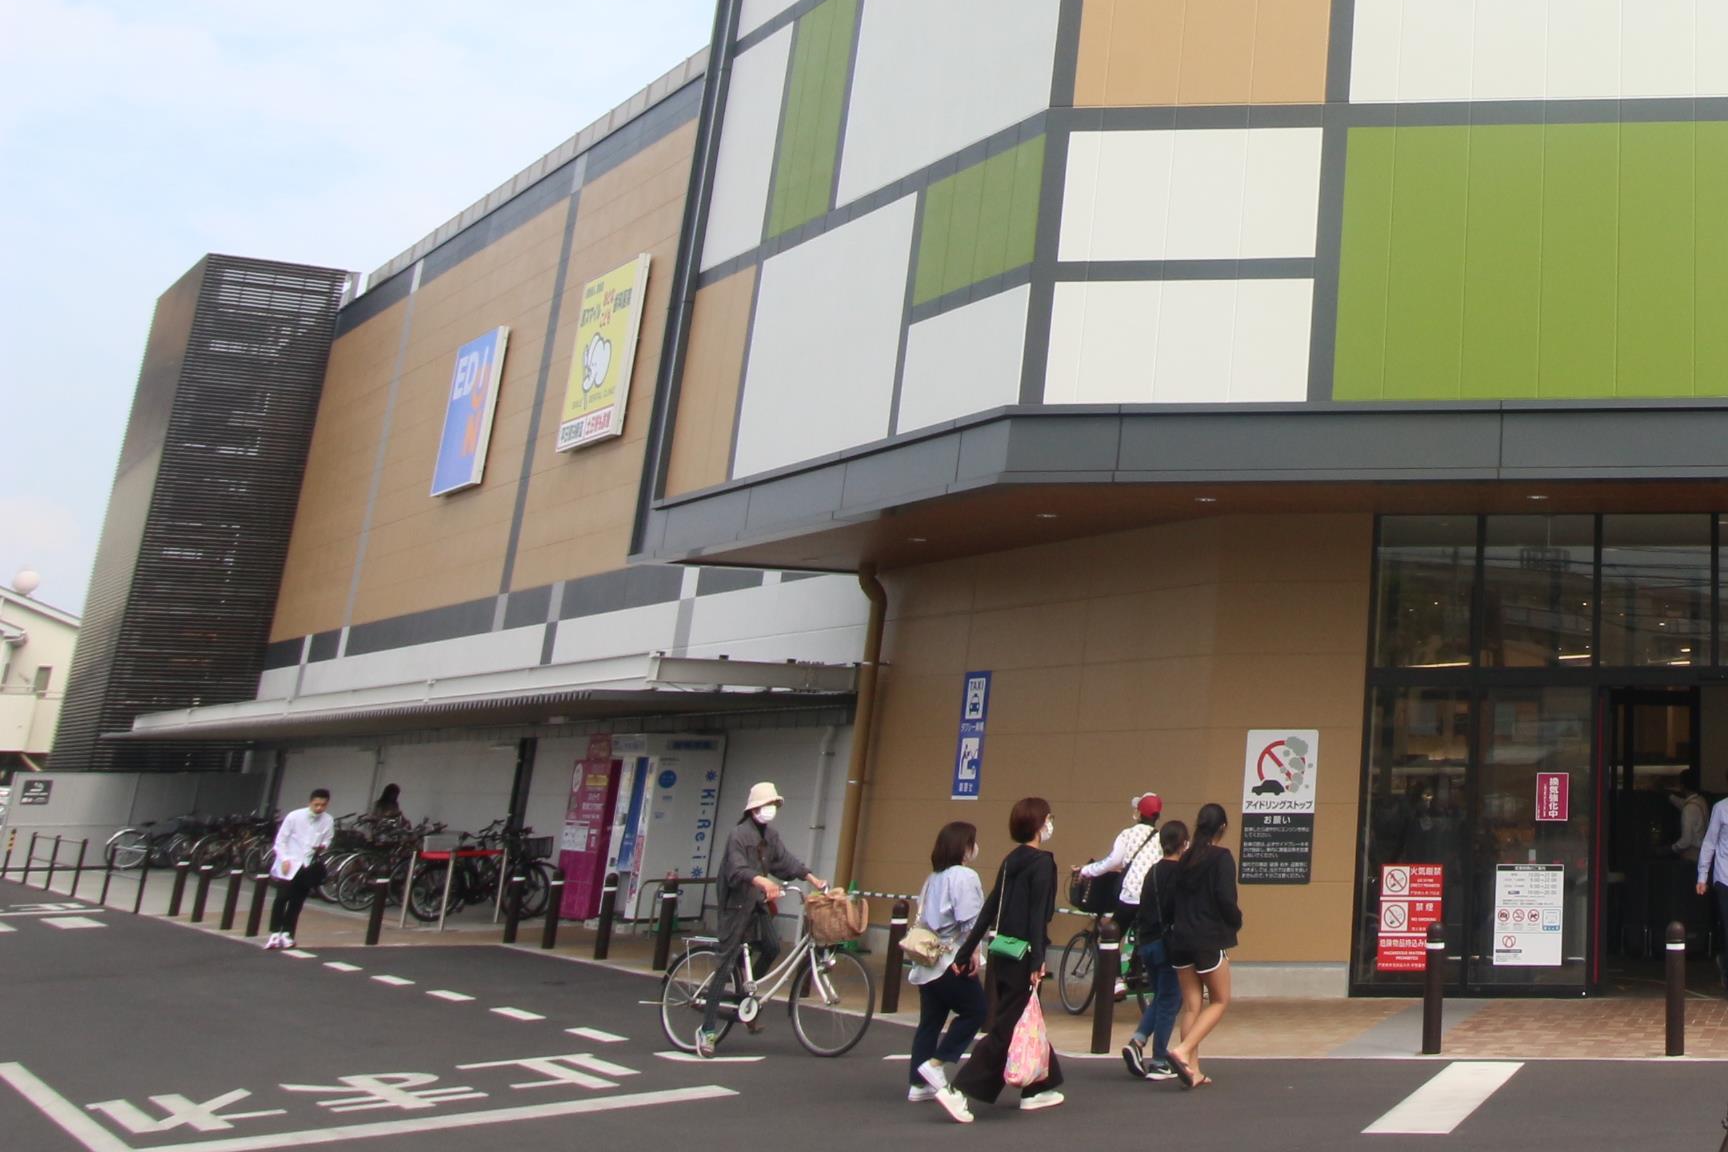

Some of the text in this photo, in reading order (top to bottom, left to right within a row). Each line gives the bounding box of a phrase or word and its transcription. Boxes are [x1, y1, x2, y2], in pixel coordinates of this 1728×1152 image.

[970, 680, 984, 691] TAXI
[1245, 799, 1314, 810] アイドリングストップ
[1263, 815, 1291, 825] お願い
[1410, 866, 1441, 876] 火気厳禁
[1380, 938, 1427, 948] 危険物品持込み
